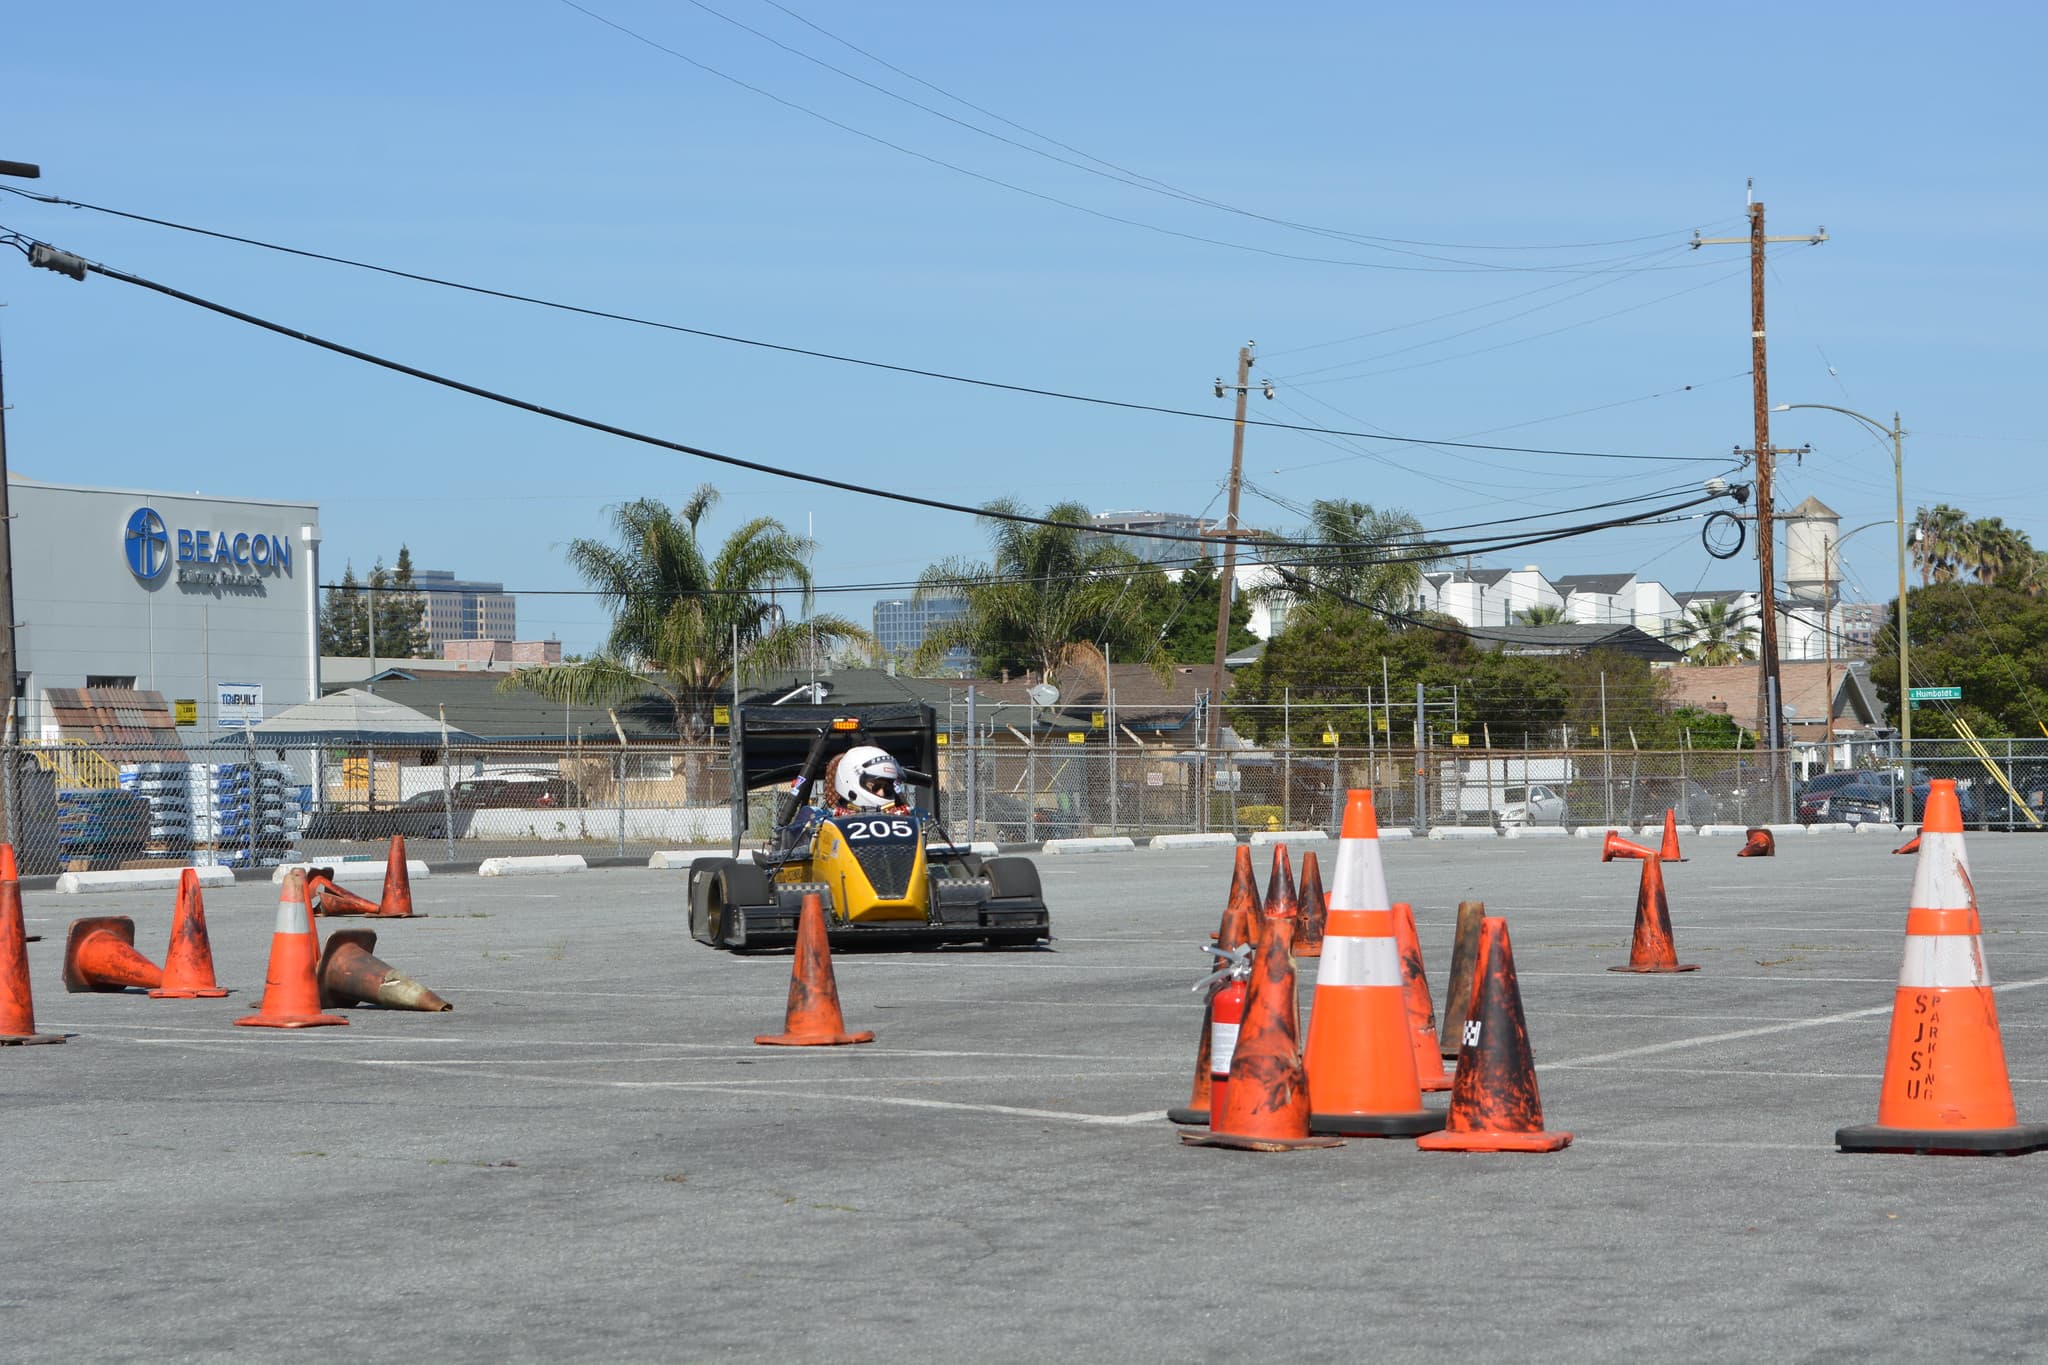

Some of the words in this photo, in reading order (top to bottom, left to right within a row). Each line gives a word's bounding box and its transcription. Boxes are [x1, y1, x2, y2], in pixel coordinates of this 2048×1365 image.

[177, 528, 289, 568] BEACON
[1916, 690, 1952, 698] Humboldt
[847, 820, 913, 839] 205
[1907, 994, 1928, 1100] SJSU
[1923, 995, 1941, 1100] PARKING
